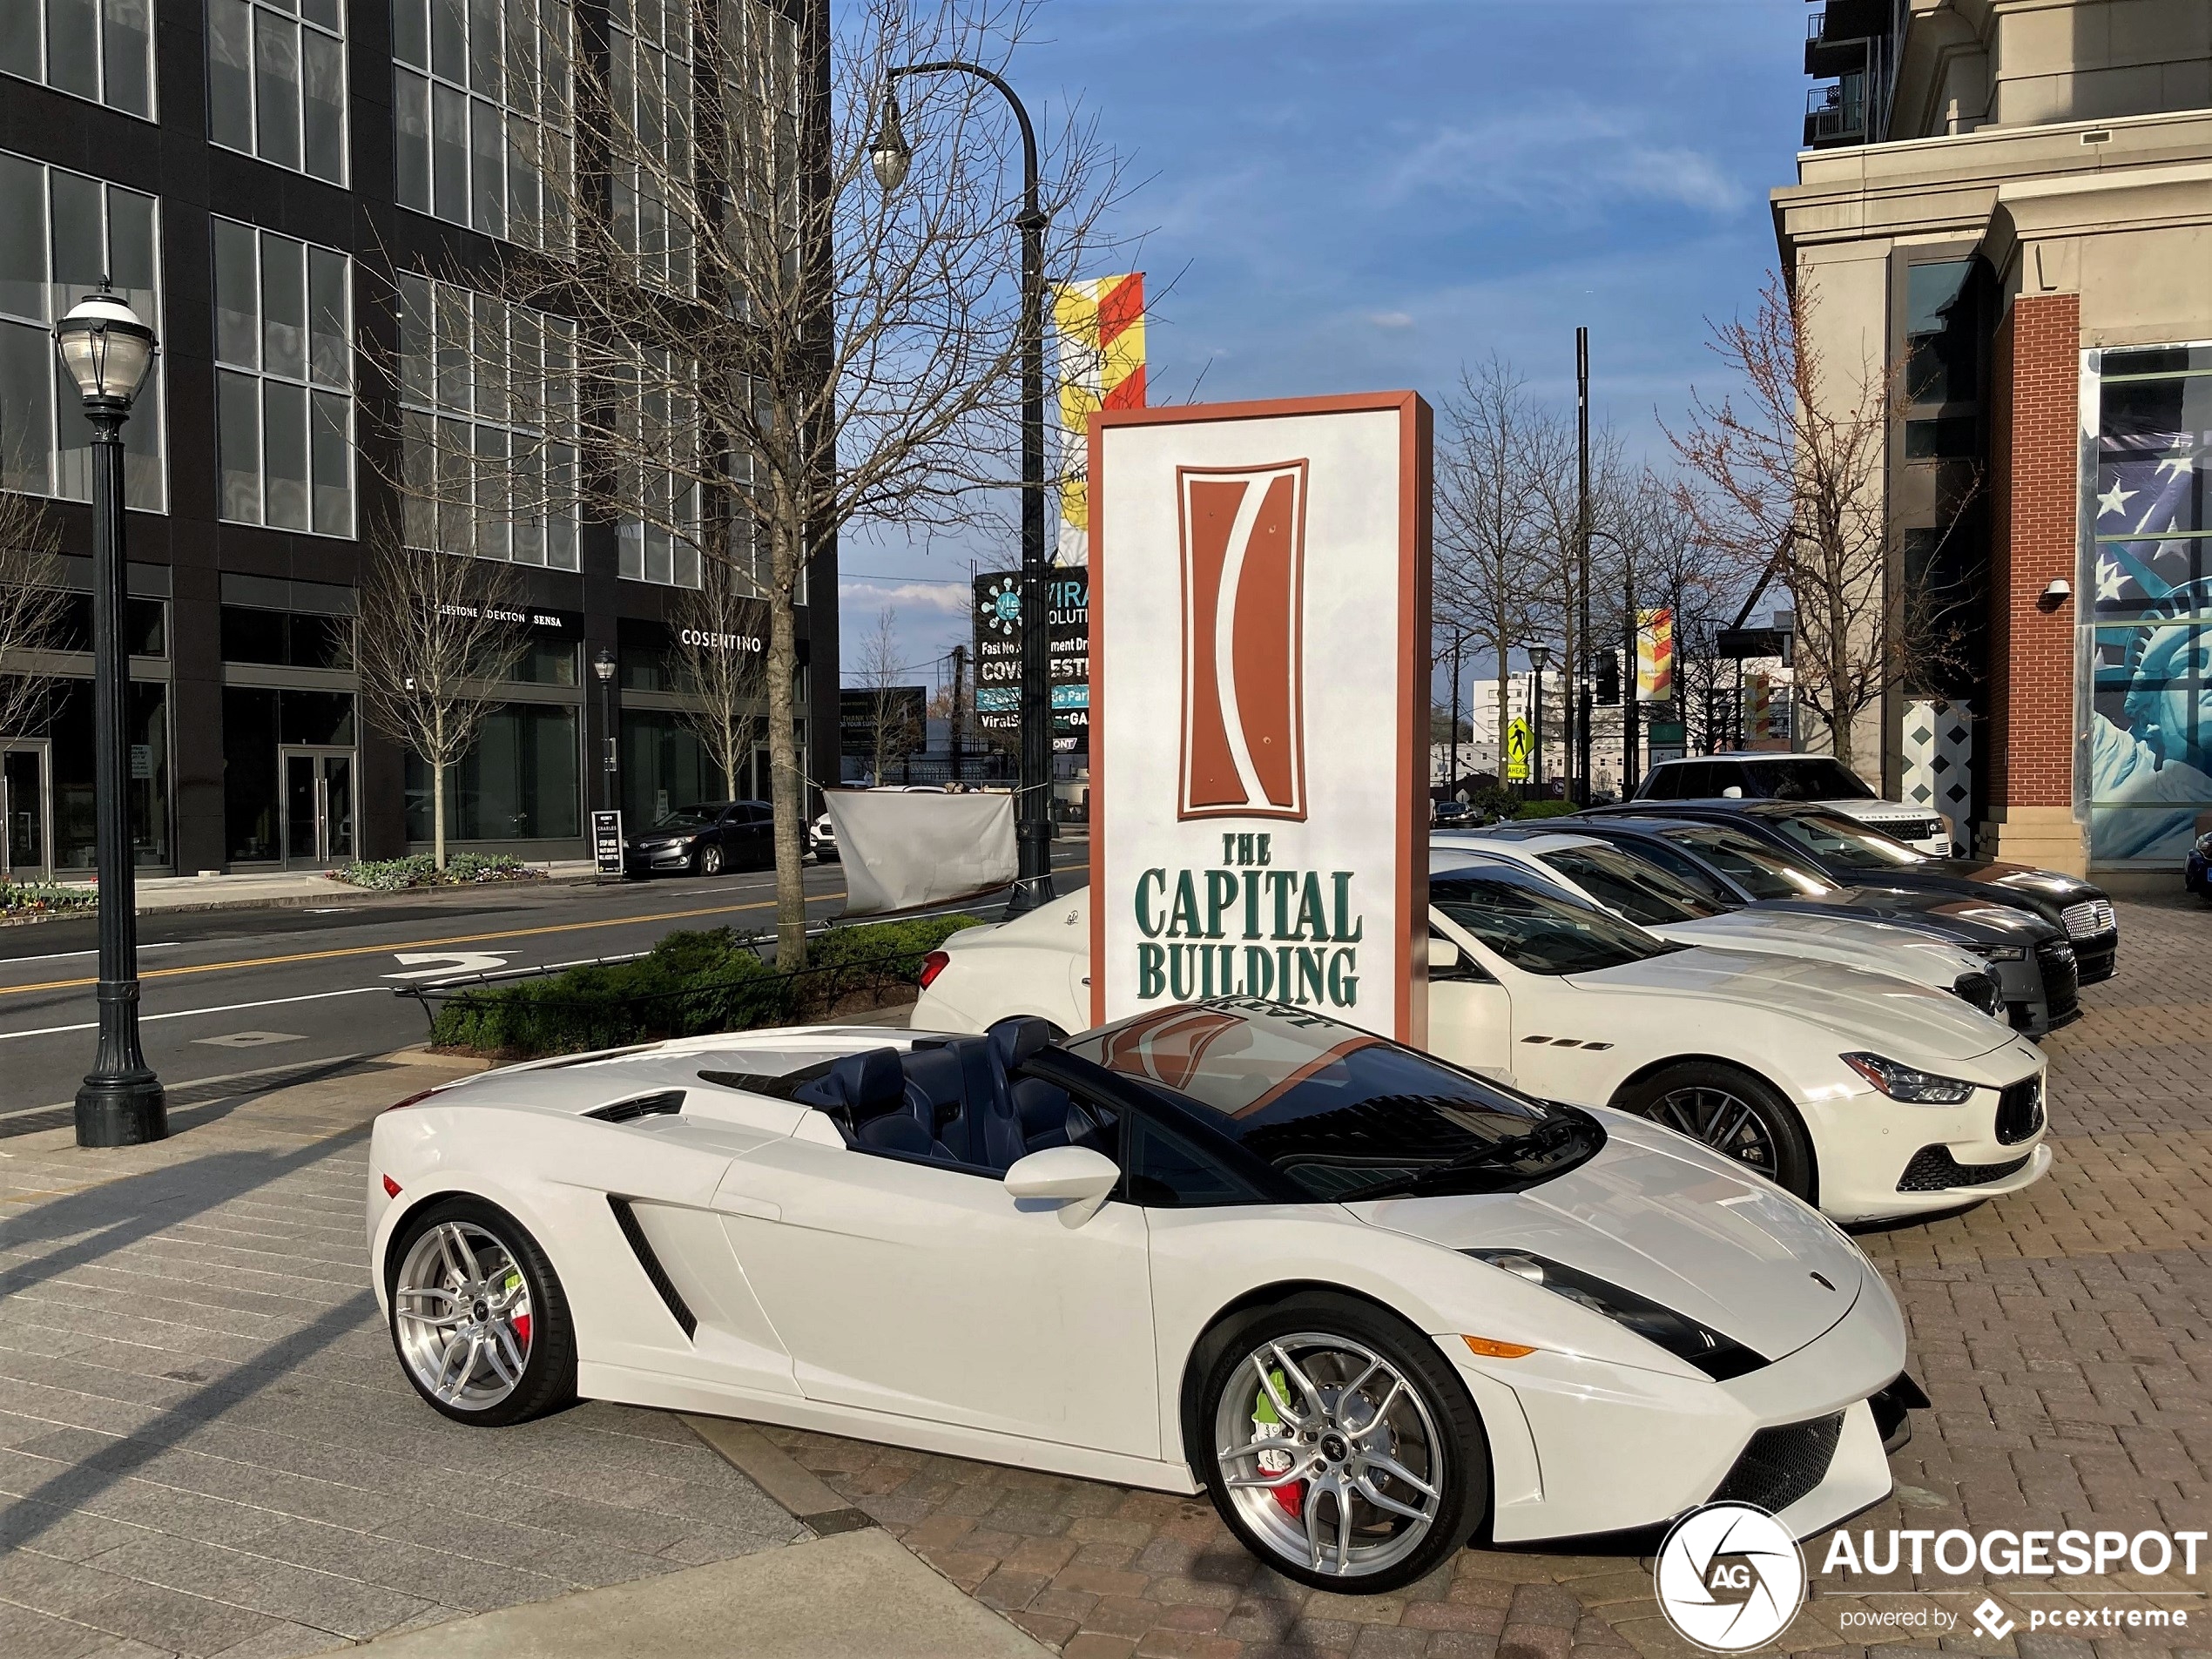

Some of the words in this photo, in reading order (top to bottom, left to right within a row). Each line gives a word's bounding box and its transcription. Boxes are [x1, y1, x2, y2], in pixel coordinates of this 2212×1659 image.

[487, 610, 525, 623] DEKTON
[533, 615, 563, 627] SENSA
[1049, 609, 1089, 624] OLUTI
[681, 629, 761, 652] COSENTINO
[981, 641, 1001, 656] Fast
[1053, 739, 1074, 748] ONT
[1222, 833, 1271, 866] THE
[1135, 867, 1363, 943] CAPITAL
[1136, 941, 1360, 1008] BUILDING
